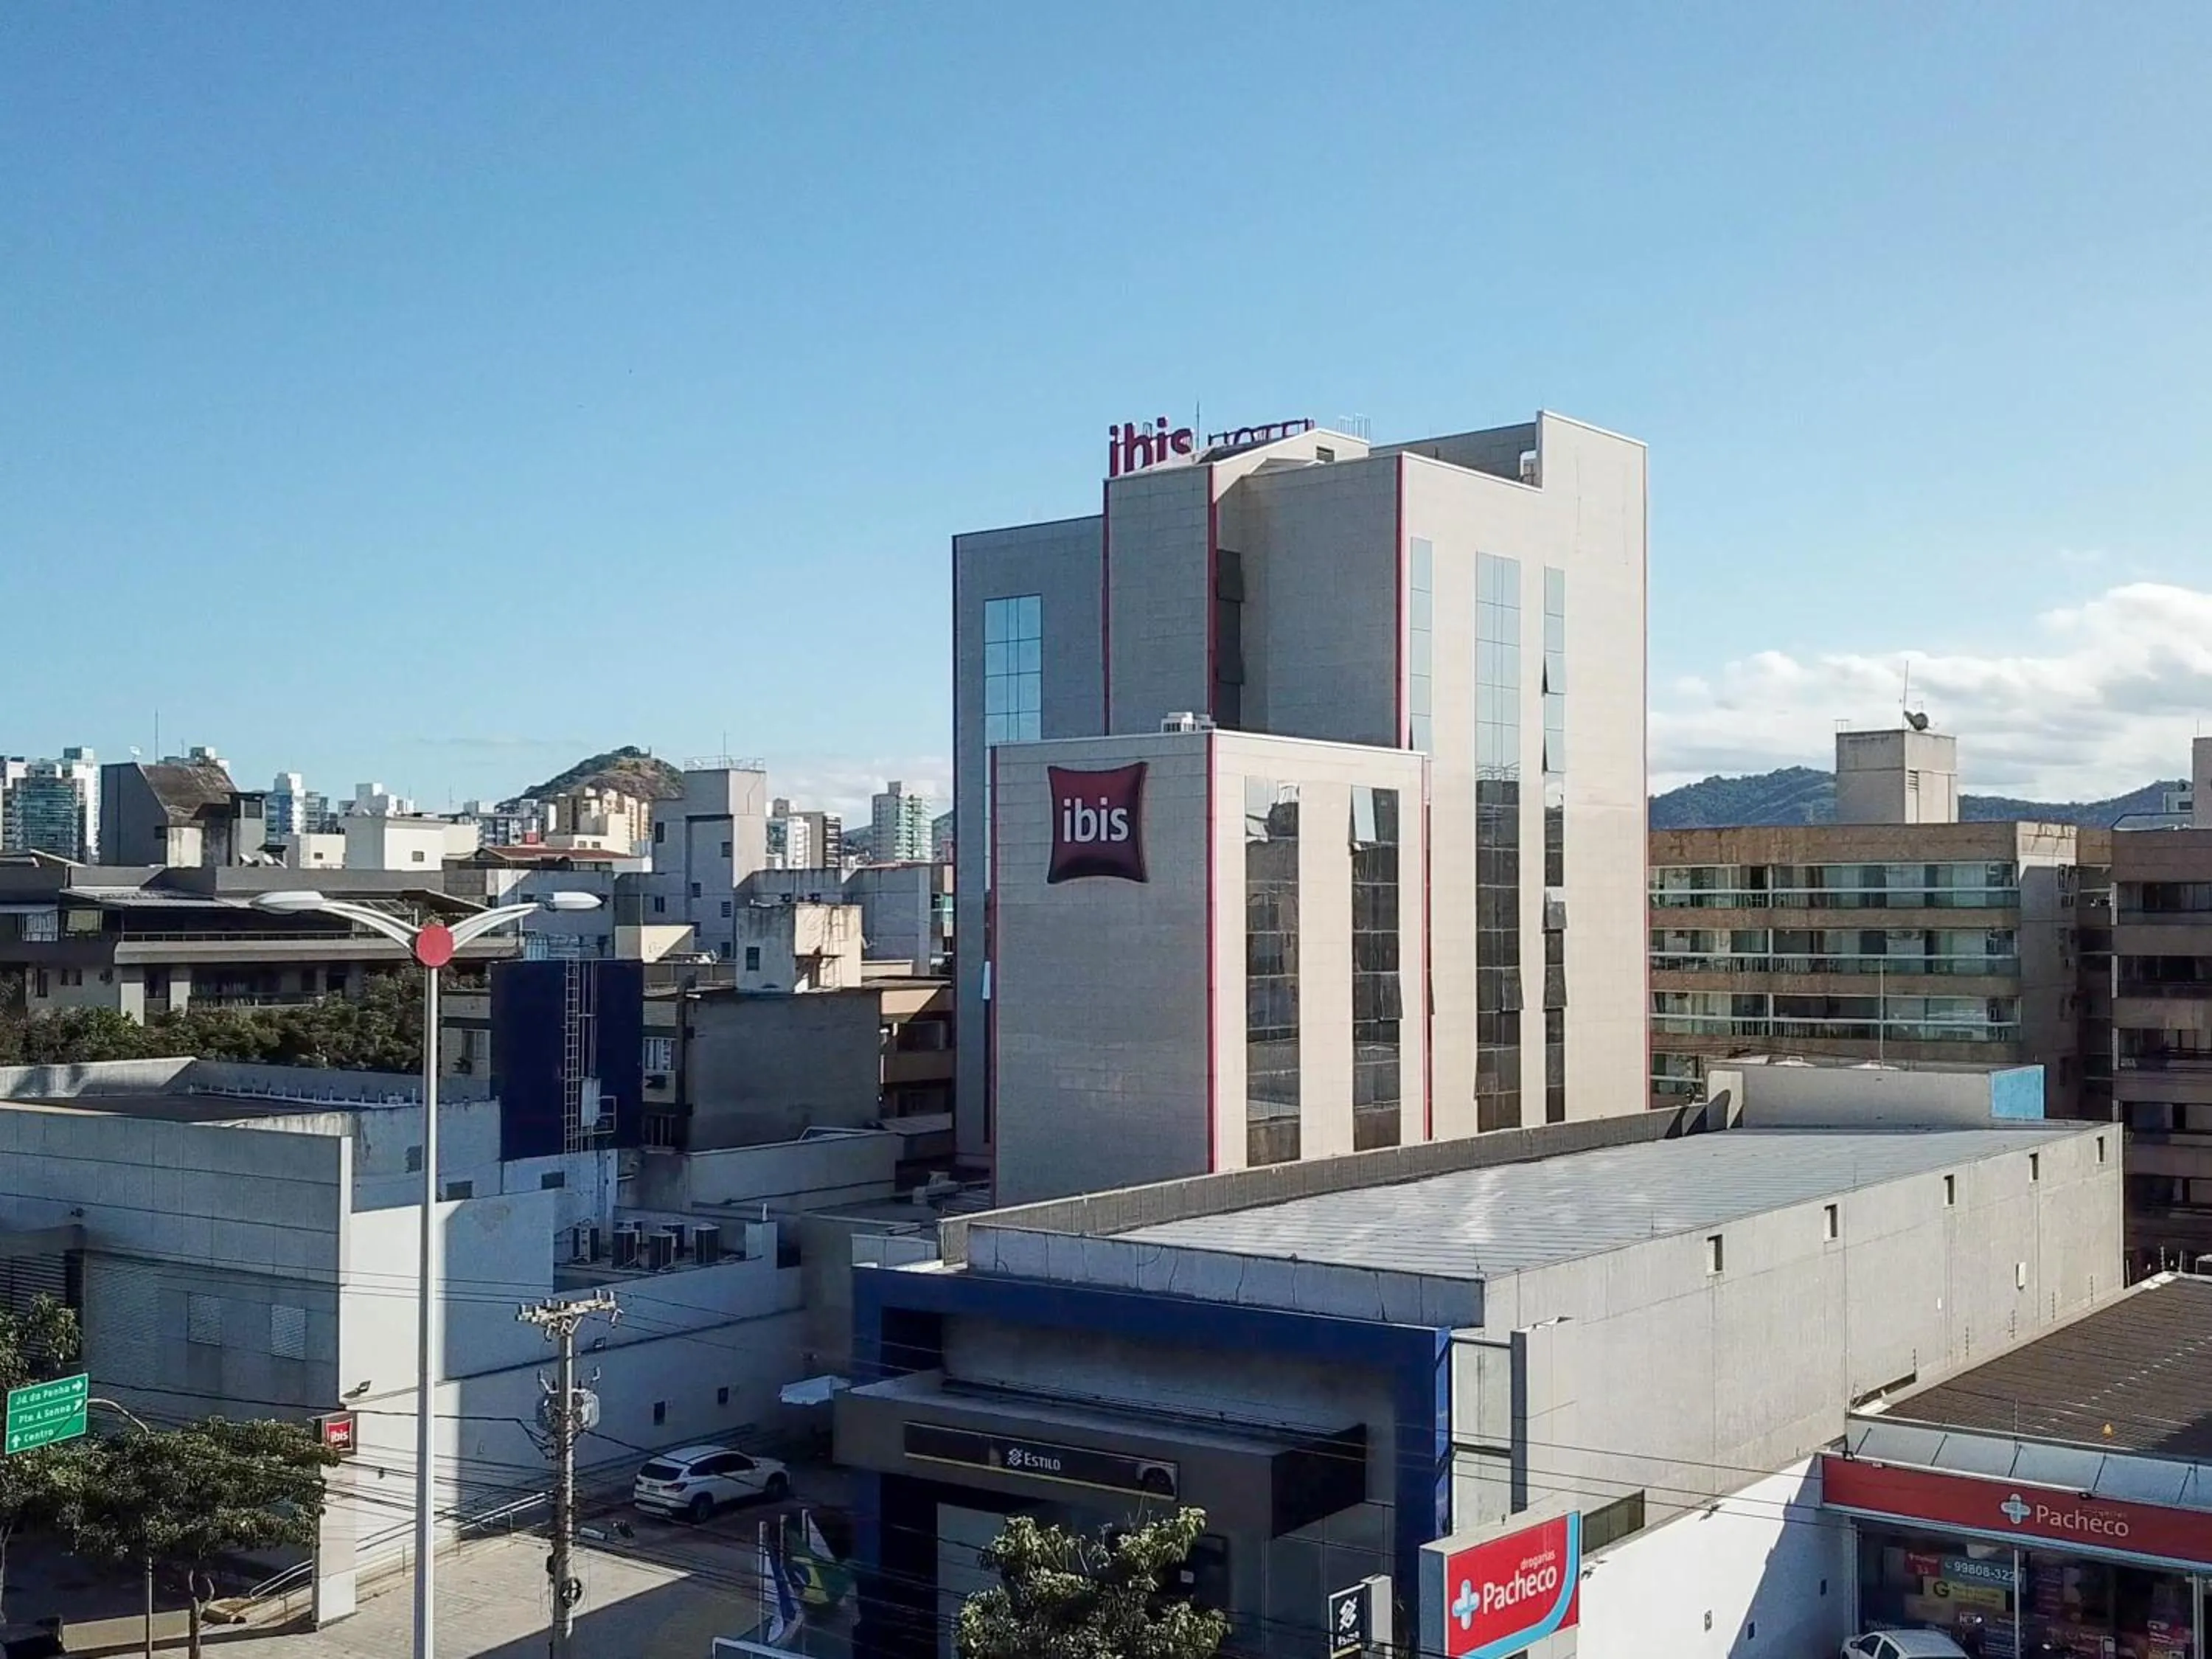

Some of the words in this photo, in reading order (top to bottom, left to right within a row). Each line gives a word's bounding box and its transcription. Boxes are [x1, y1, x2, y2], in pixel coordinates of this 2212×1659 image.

[1063, 797, 1129, 843] ibis
[29, 1393, 41, 1402] da
[43, 1386, 70, 1398] Penha
[44, 1405, 72, 1417] Senna
[24, 1429, 54, 1443] Centro
[1024, 1452, 1061, 1471] ESTILO
[2036, 1504, 2129, 1537] Pacheco
[1520, 1550, 1556, 1571] drogarias
[1483, 1565, 1557, 1614] Pacheco
